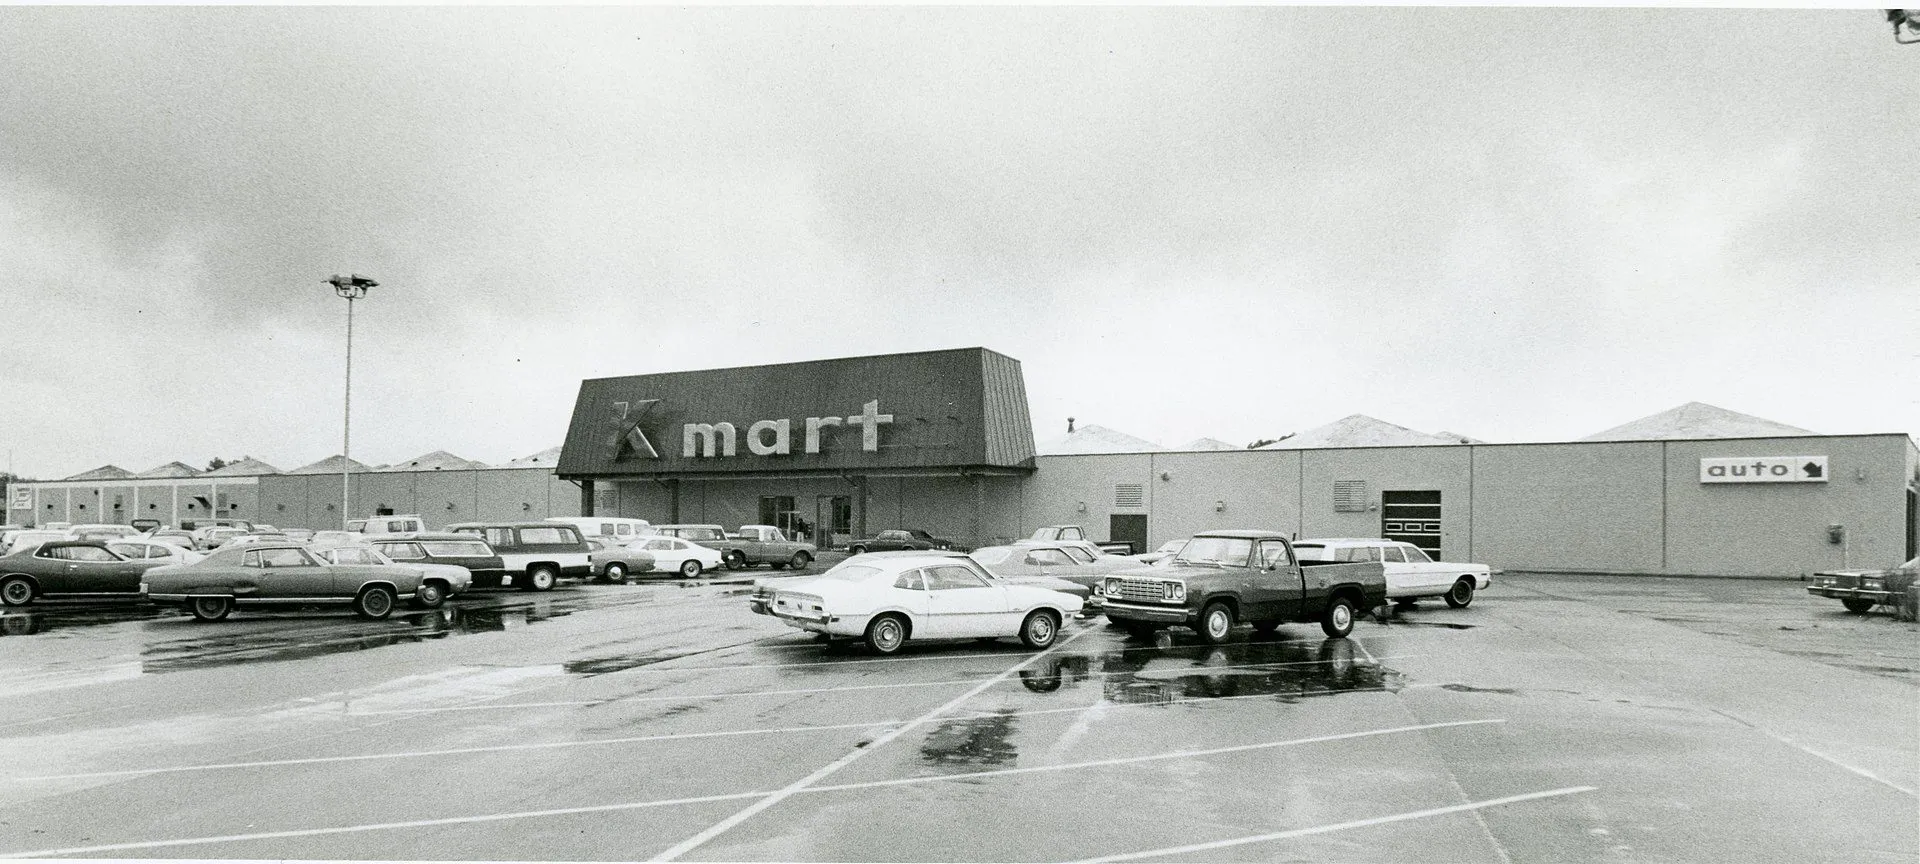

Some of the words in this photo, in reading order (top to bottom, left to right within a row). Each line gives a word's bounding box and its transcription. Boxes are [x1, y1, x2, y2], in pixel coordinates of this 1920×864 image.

[612, 398, 661, 461] K
[683, 399, 893, 457] mart
[1707, 461, 1788, 476] auto
